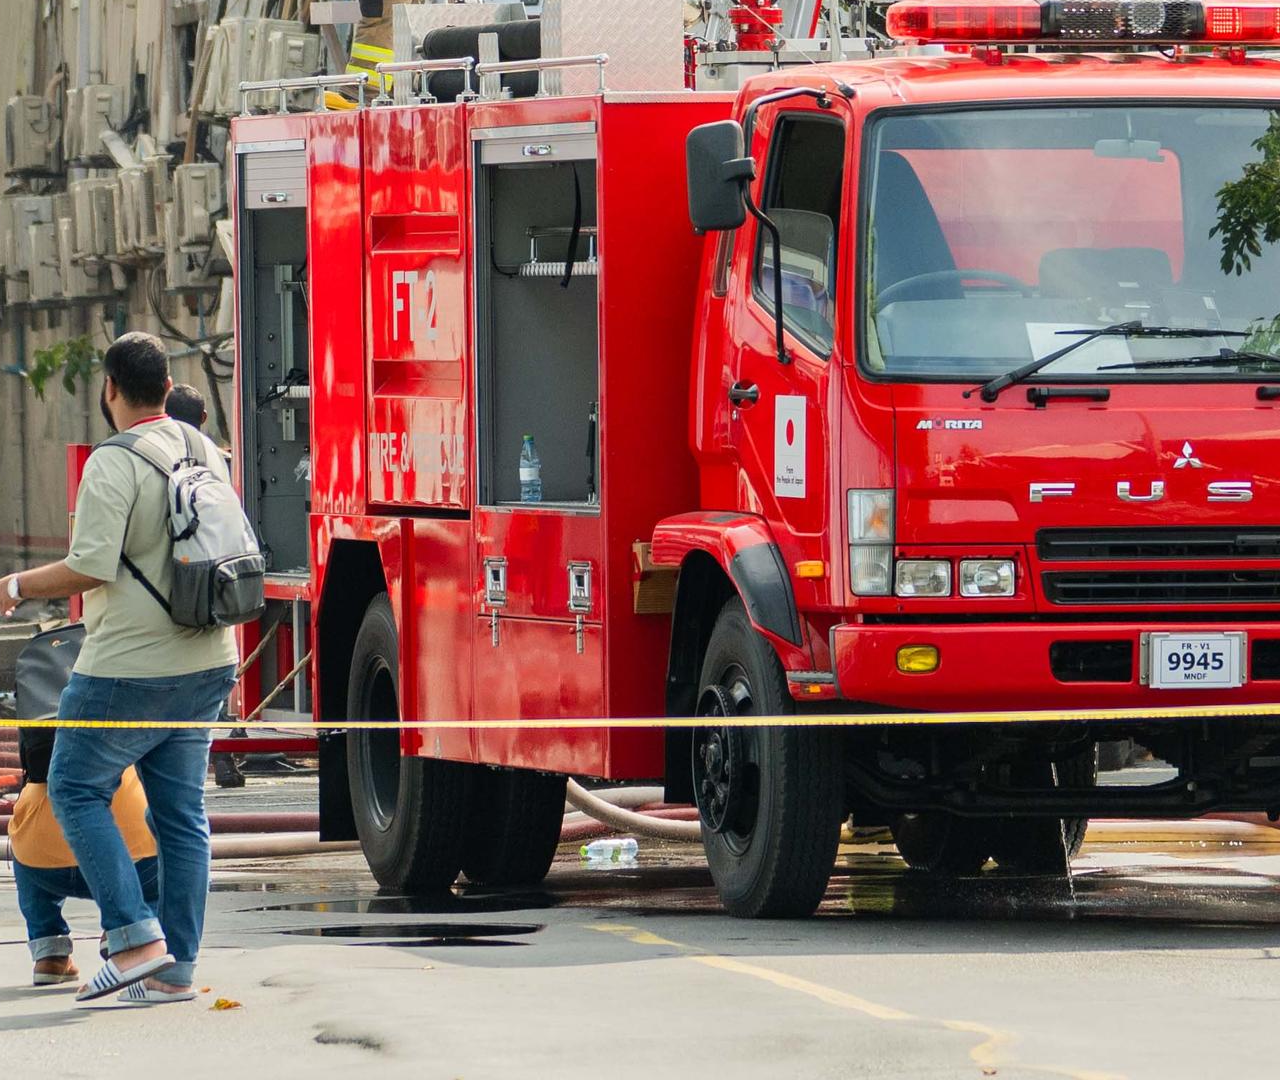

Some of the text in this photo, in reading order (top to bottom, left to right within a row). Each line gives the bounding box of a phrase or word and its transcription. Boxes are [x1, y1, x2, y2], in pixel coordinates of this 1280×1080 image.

[916, 418, 983, 430] MORITA
[370, 432, 465, 474] FIRE & RCUE
[1168, 652, 1224, 671] 9945
[1184, 672, 1208, 681] MNDF
